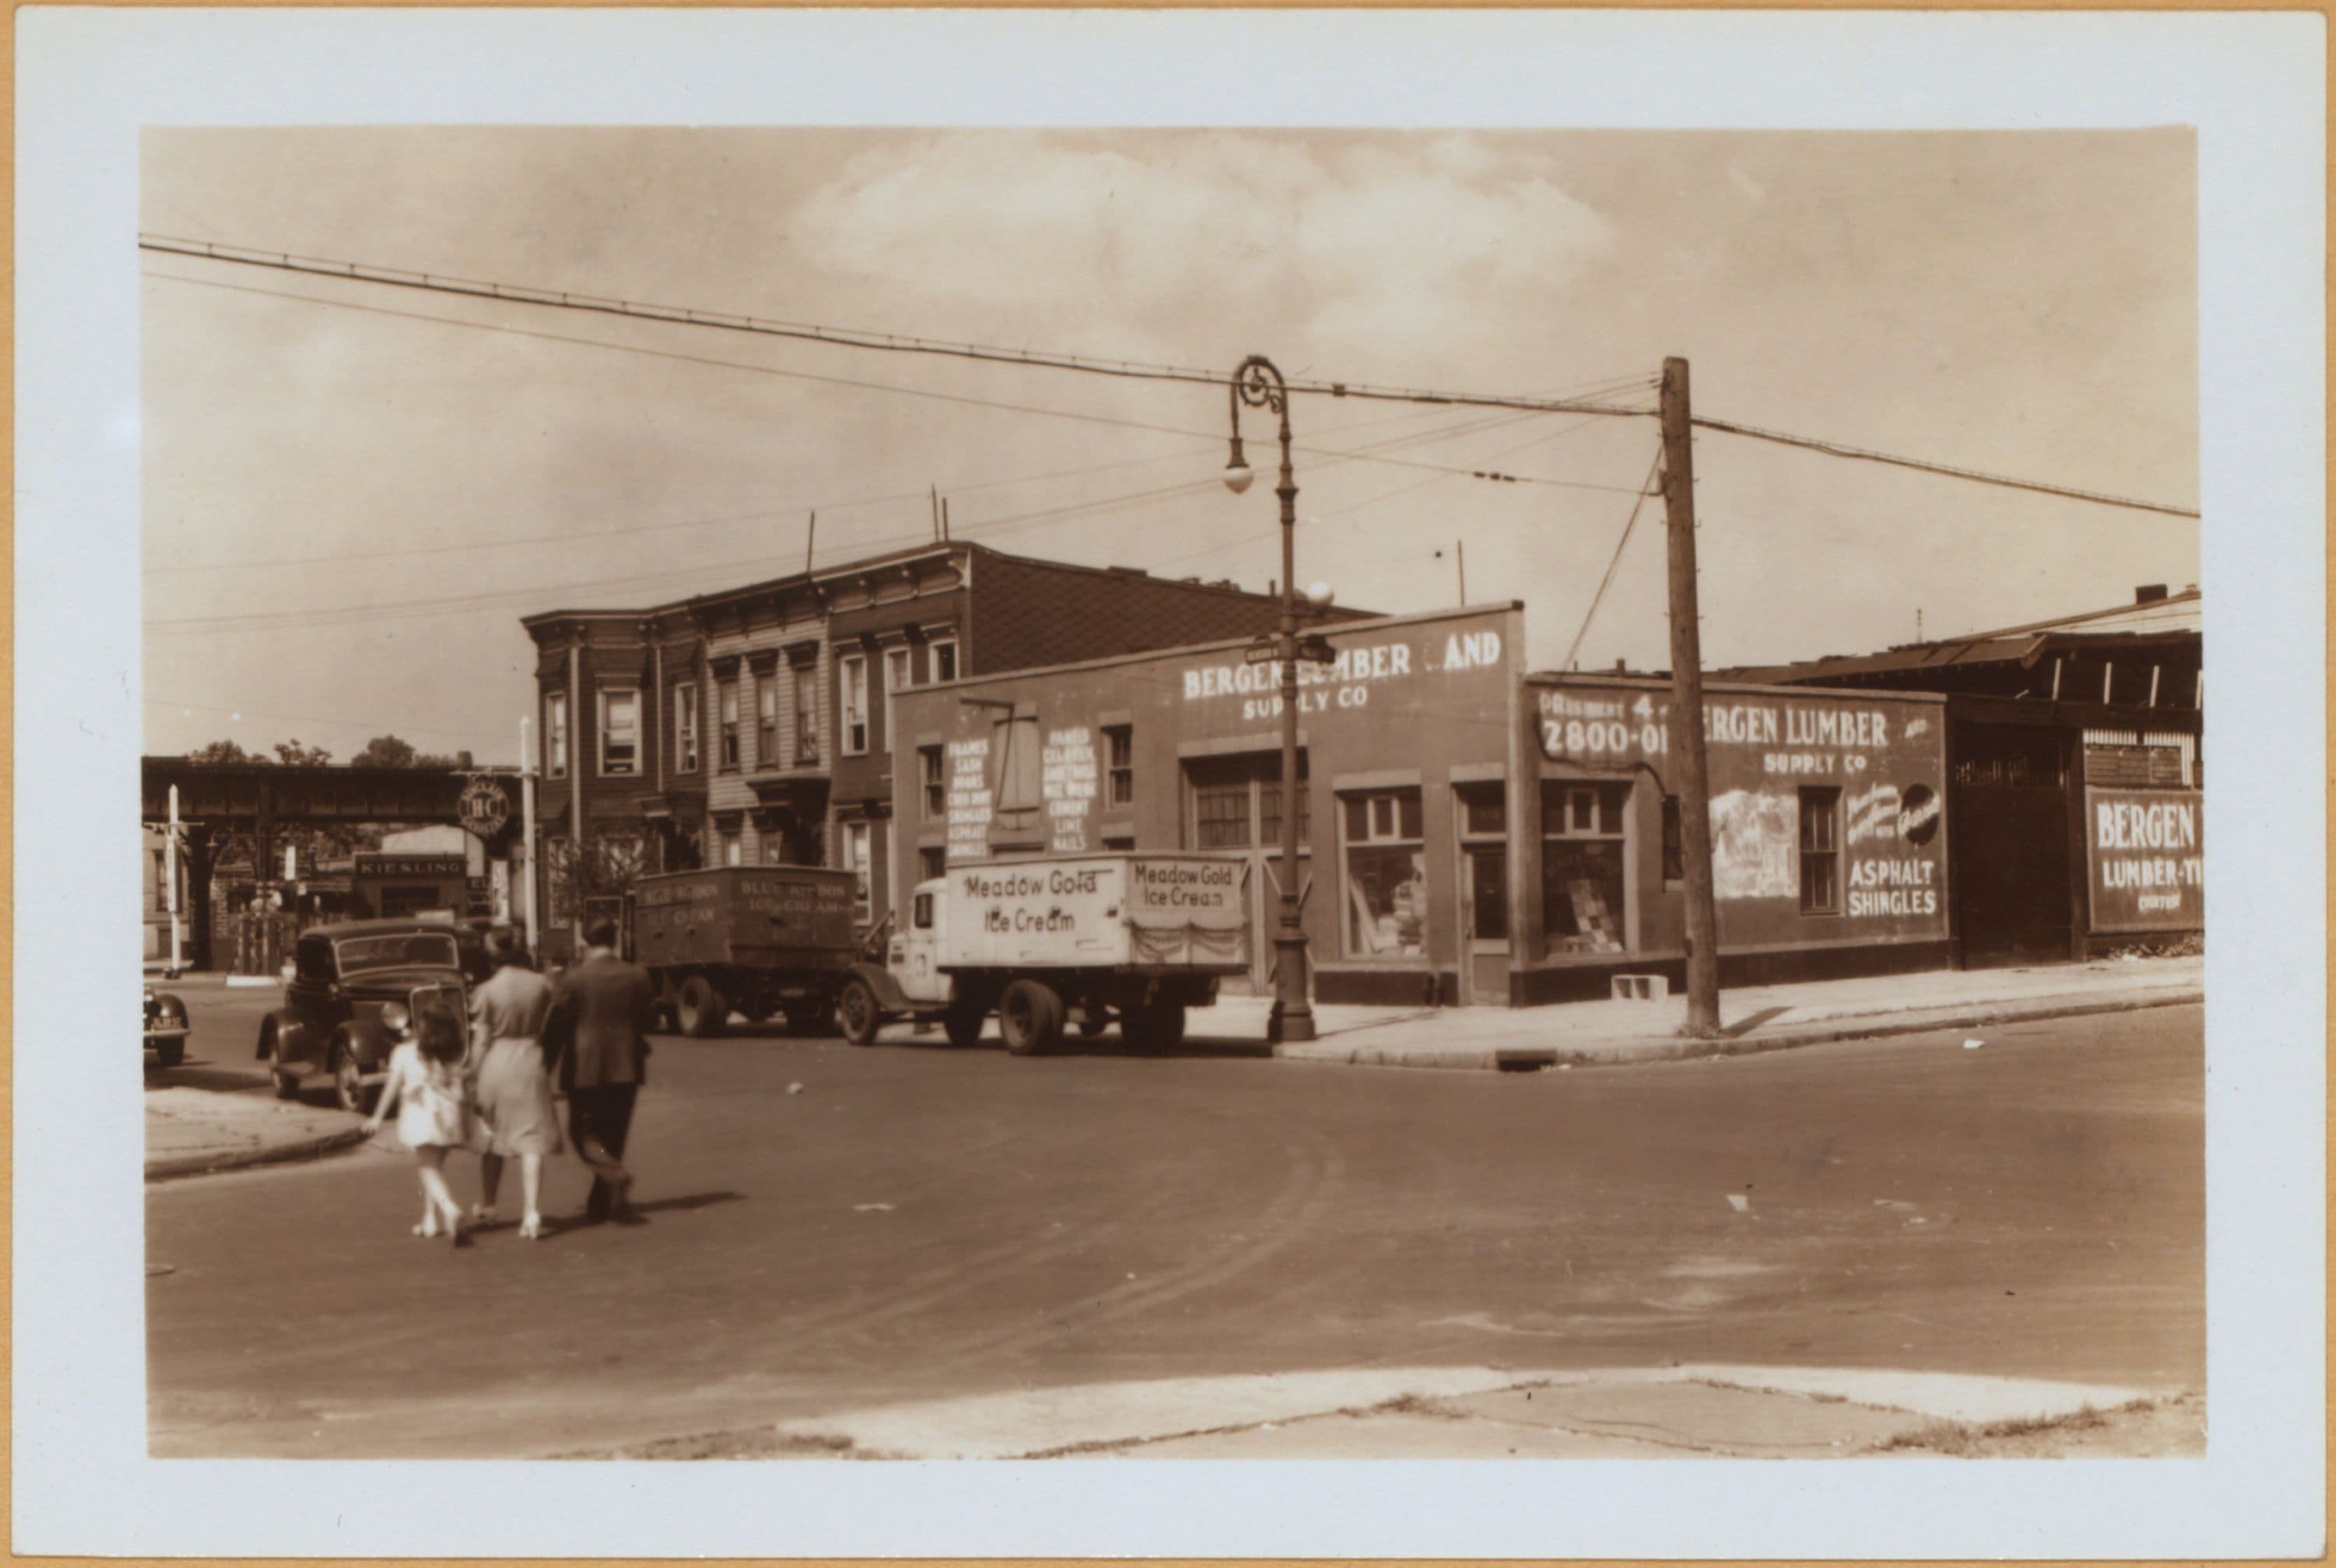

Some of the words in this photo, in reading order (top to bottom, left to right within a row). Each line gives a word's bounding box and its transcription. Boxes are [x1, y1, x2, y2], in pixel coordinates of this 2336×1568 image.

[1183, 661, 1284, 700] BERGEN
[1444, 632, 1501, 671] AND
[1243, 691, 1329, 720] SUPLY
[1337, 686, 1368, 708] CO
[1702, 704, 1778, 743] ERGEN
[1786, 705, 1888, 747] LUMBER
[955, 756, 983, 773] SASH
[1763, 752, 1835, 773] SUPPLY
[1843, 753, 1867, 773] CO
[1056, 818, 1082, 834] LIME
[2096, 802, 2195, 848] BERGEN
[1052, 835, 1086, 851] NAILS
[360, 861, 461, 874] KIESLING
[1135, 865, 1198, 884] Meadow
[1201, 867, 1233, 886] Gold
[1849, 858, 1935, 886] ASPHALT
[964, 875, 1044, 899] Meadow
[1049, 869, 1098, 894] Gold
[1144, 889, 1168, 906] Ice
[1171, 887, 1223, 907] Cream
[1848, 889, 1937, 917] SHINGLES
[985, 909, 1010, 932] Ice
[1015, 908, 1076, 932] Cream
